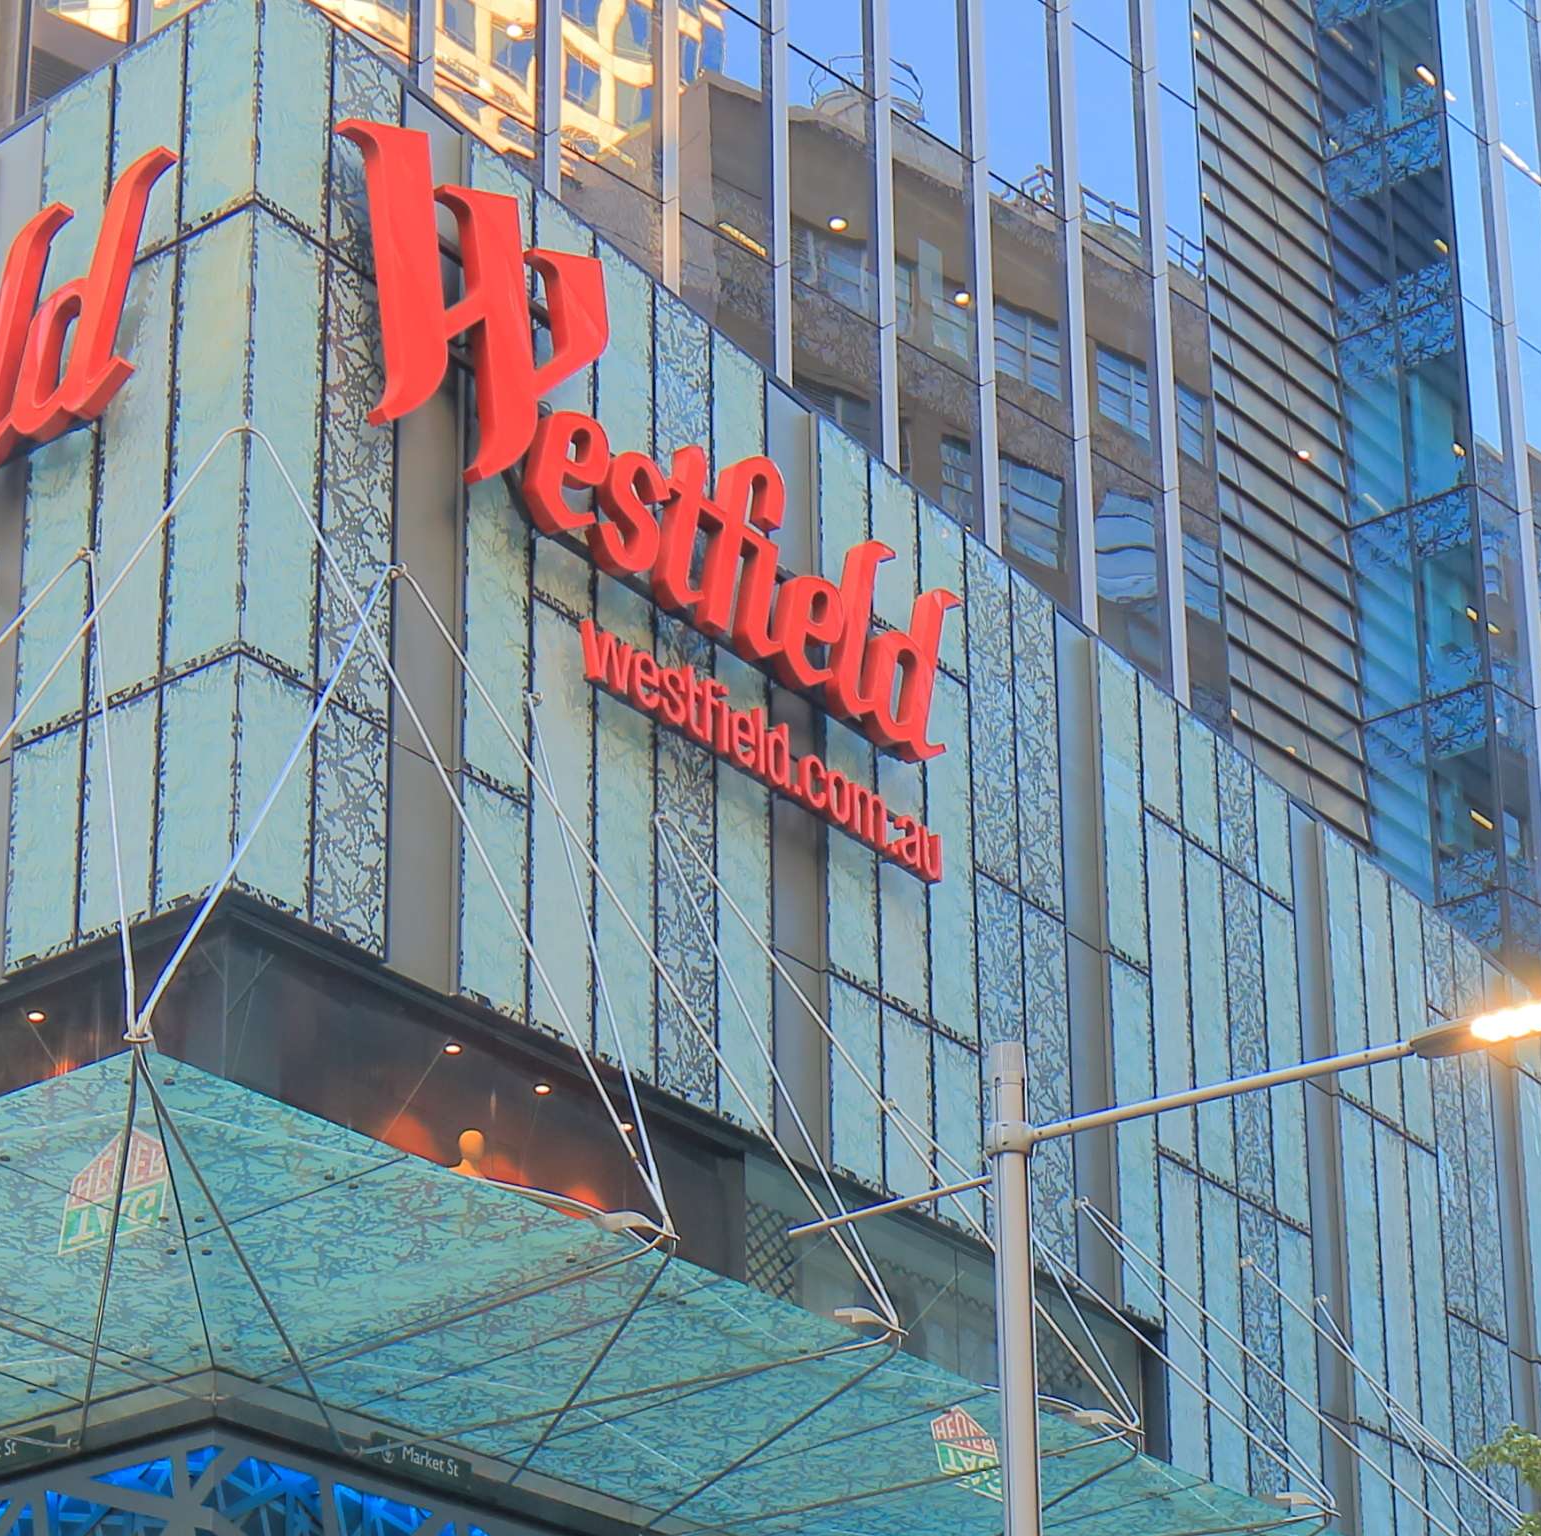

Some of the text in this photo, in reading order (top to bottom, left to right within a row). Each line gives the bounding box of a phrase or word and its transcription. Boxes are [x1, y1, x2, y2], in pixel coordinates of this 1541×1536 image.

[334, 117, 962, 764] Westfield
[580, 618, 944, 886] westfield.com.au
[4, 1439, 17, 1457] St
[401, 1446, 459, 1476] Market St
